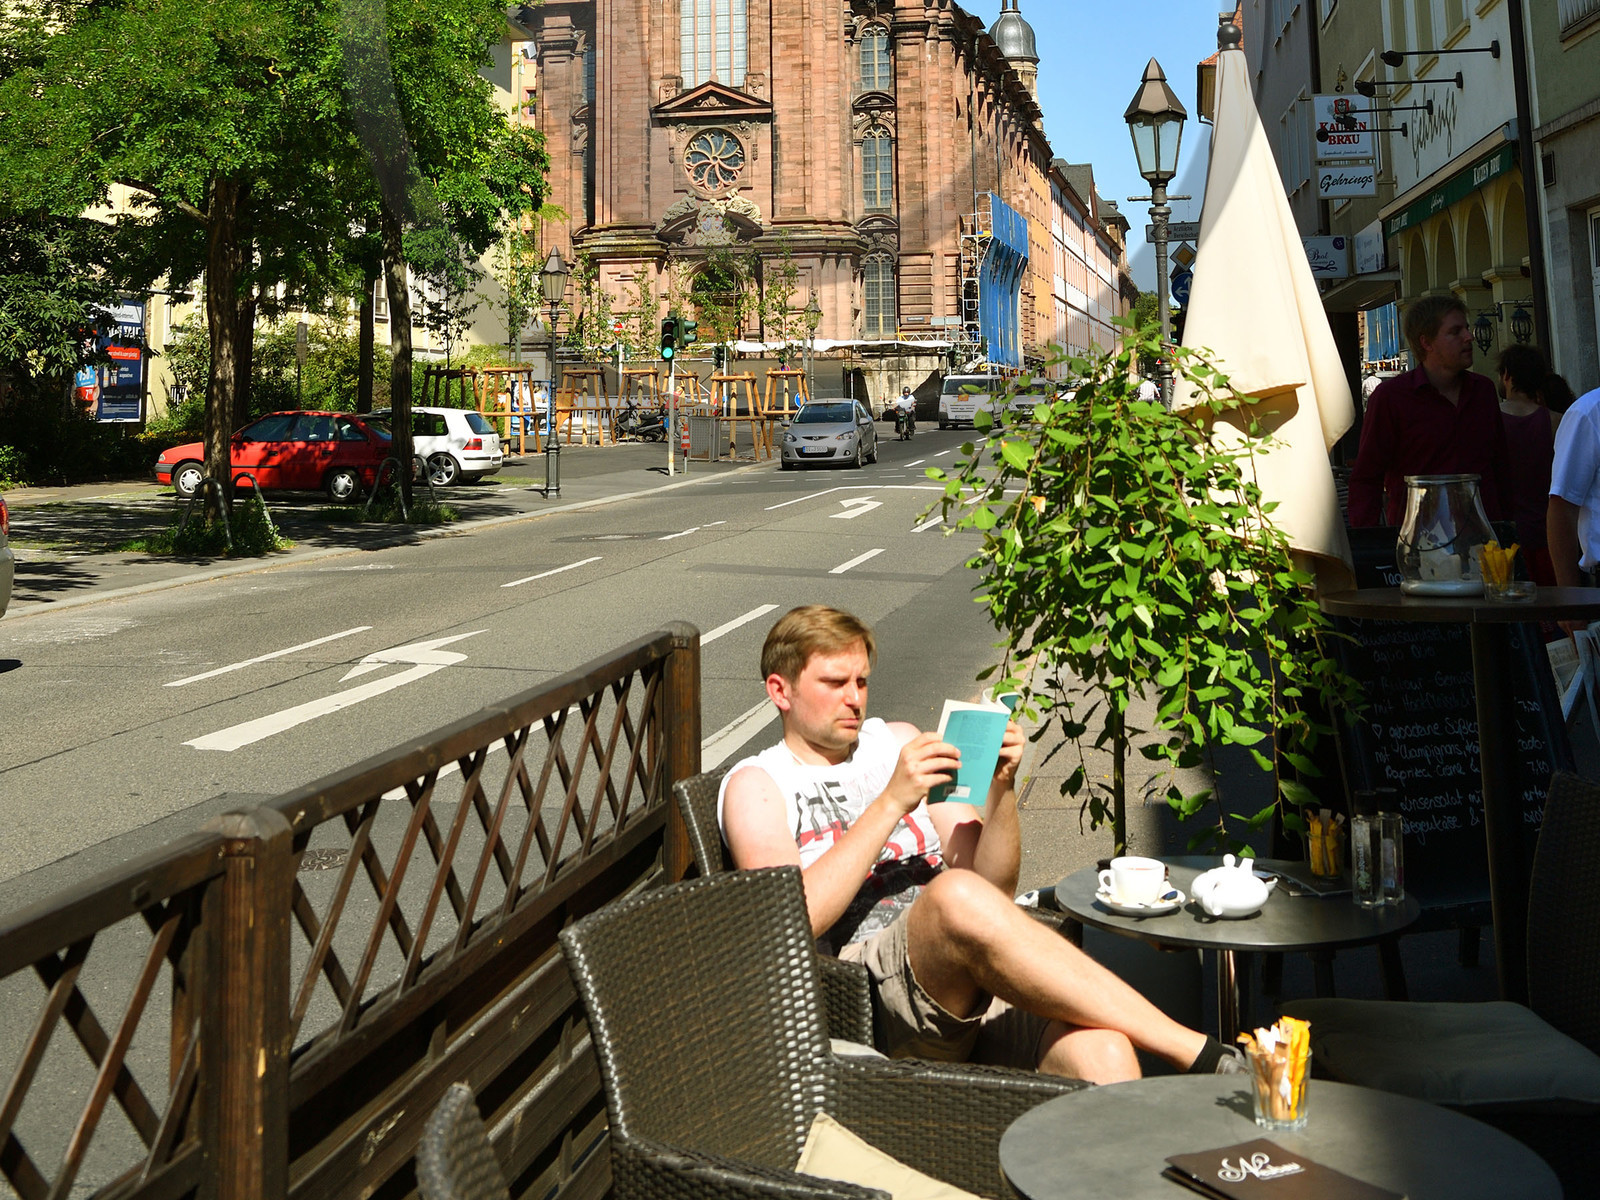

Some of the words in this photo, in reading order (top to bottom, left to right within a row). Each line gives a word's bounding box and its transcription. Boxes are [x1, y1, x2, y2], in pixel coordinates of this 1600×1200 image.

[1319, 121, 1367, 132] KAUN
[1328, 134, 1361, 145] BRÄU
[1320, 173, 1374, 193] Gehrings
